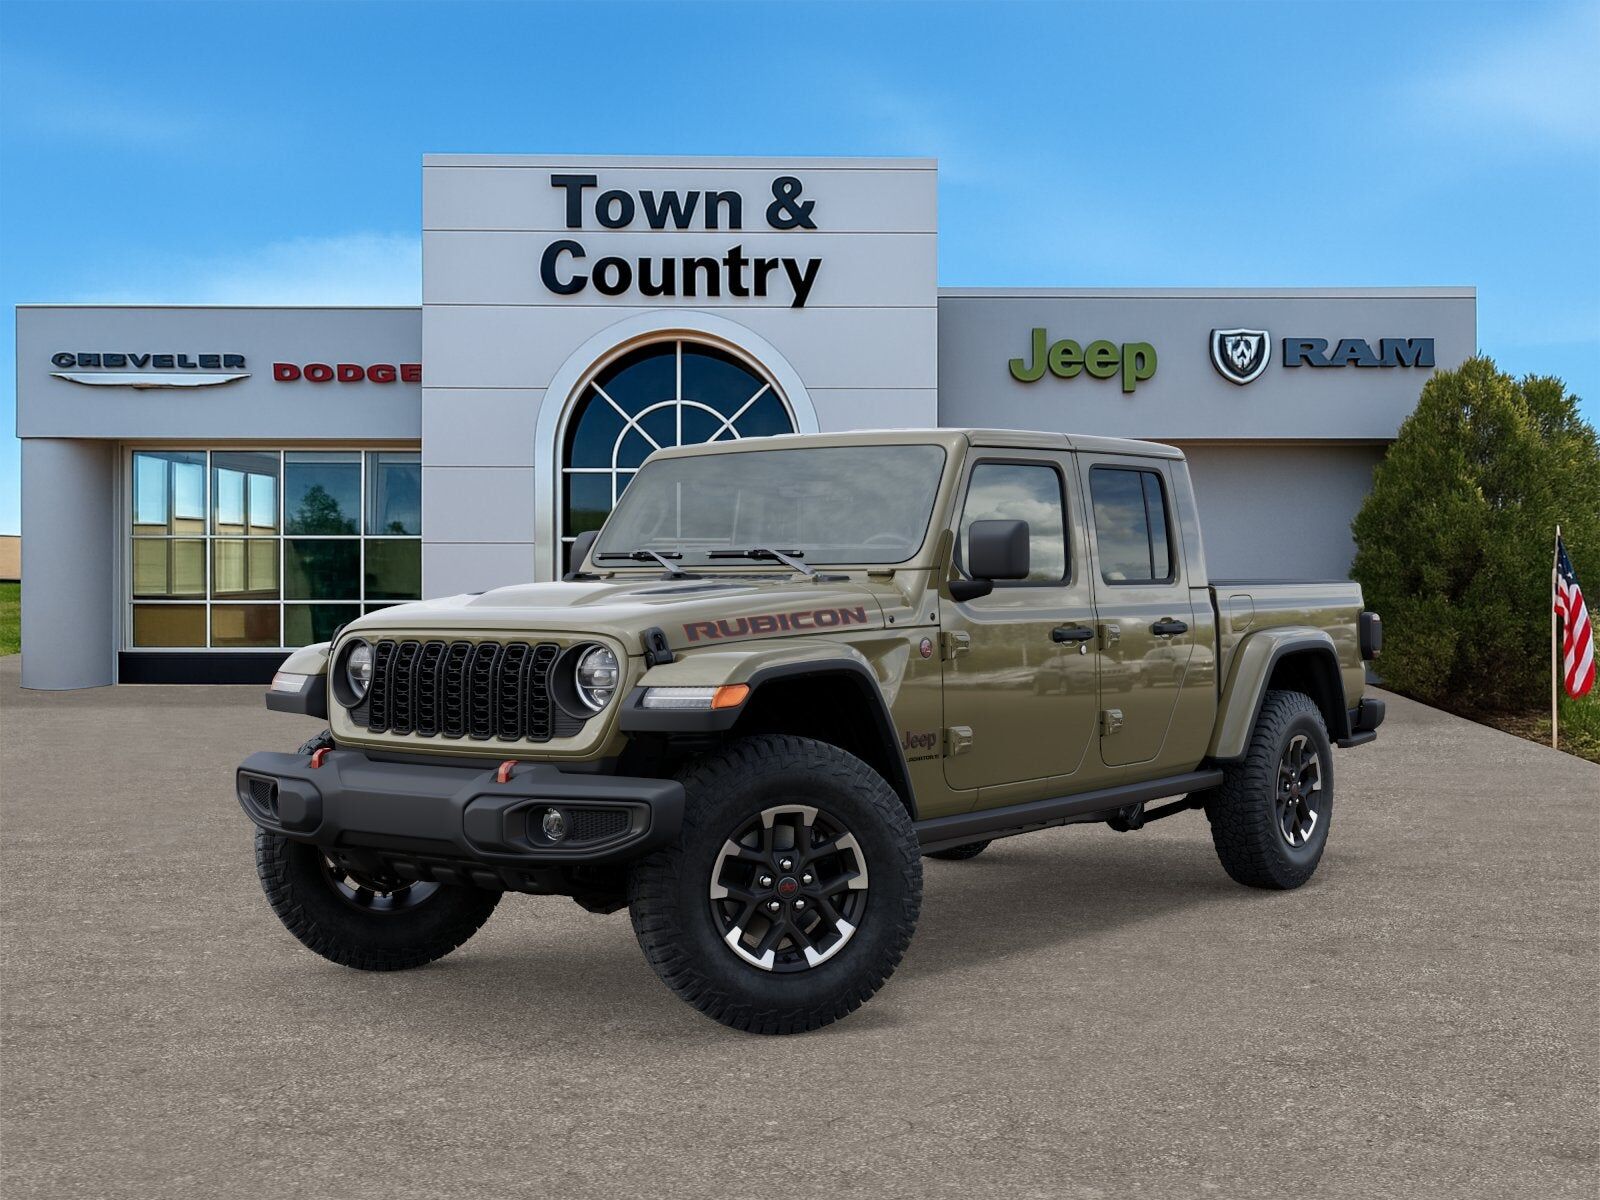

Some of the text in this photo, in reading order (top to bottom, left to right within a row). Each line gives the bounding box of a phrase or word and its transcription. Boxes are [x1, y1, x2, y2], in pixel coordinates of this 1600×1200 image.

[551, 174, 818, 230] Town &
[540, 239, 822, 308] Country
[1008, 327, 1158, 393] Jeep
[1282, 337, 1436, 368] RAM
[273, 363, 422, 383] DODGE
[683, 606, 868, 642] RUBICON
[901, 730, 937, 751] Jeep
